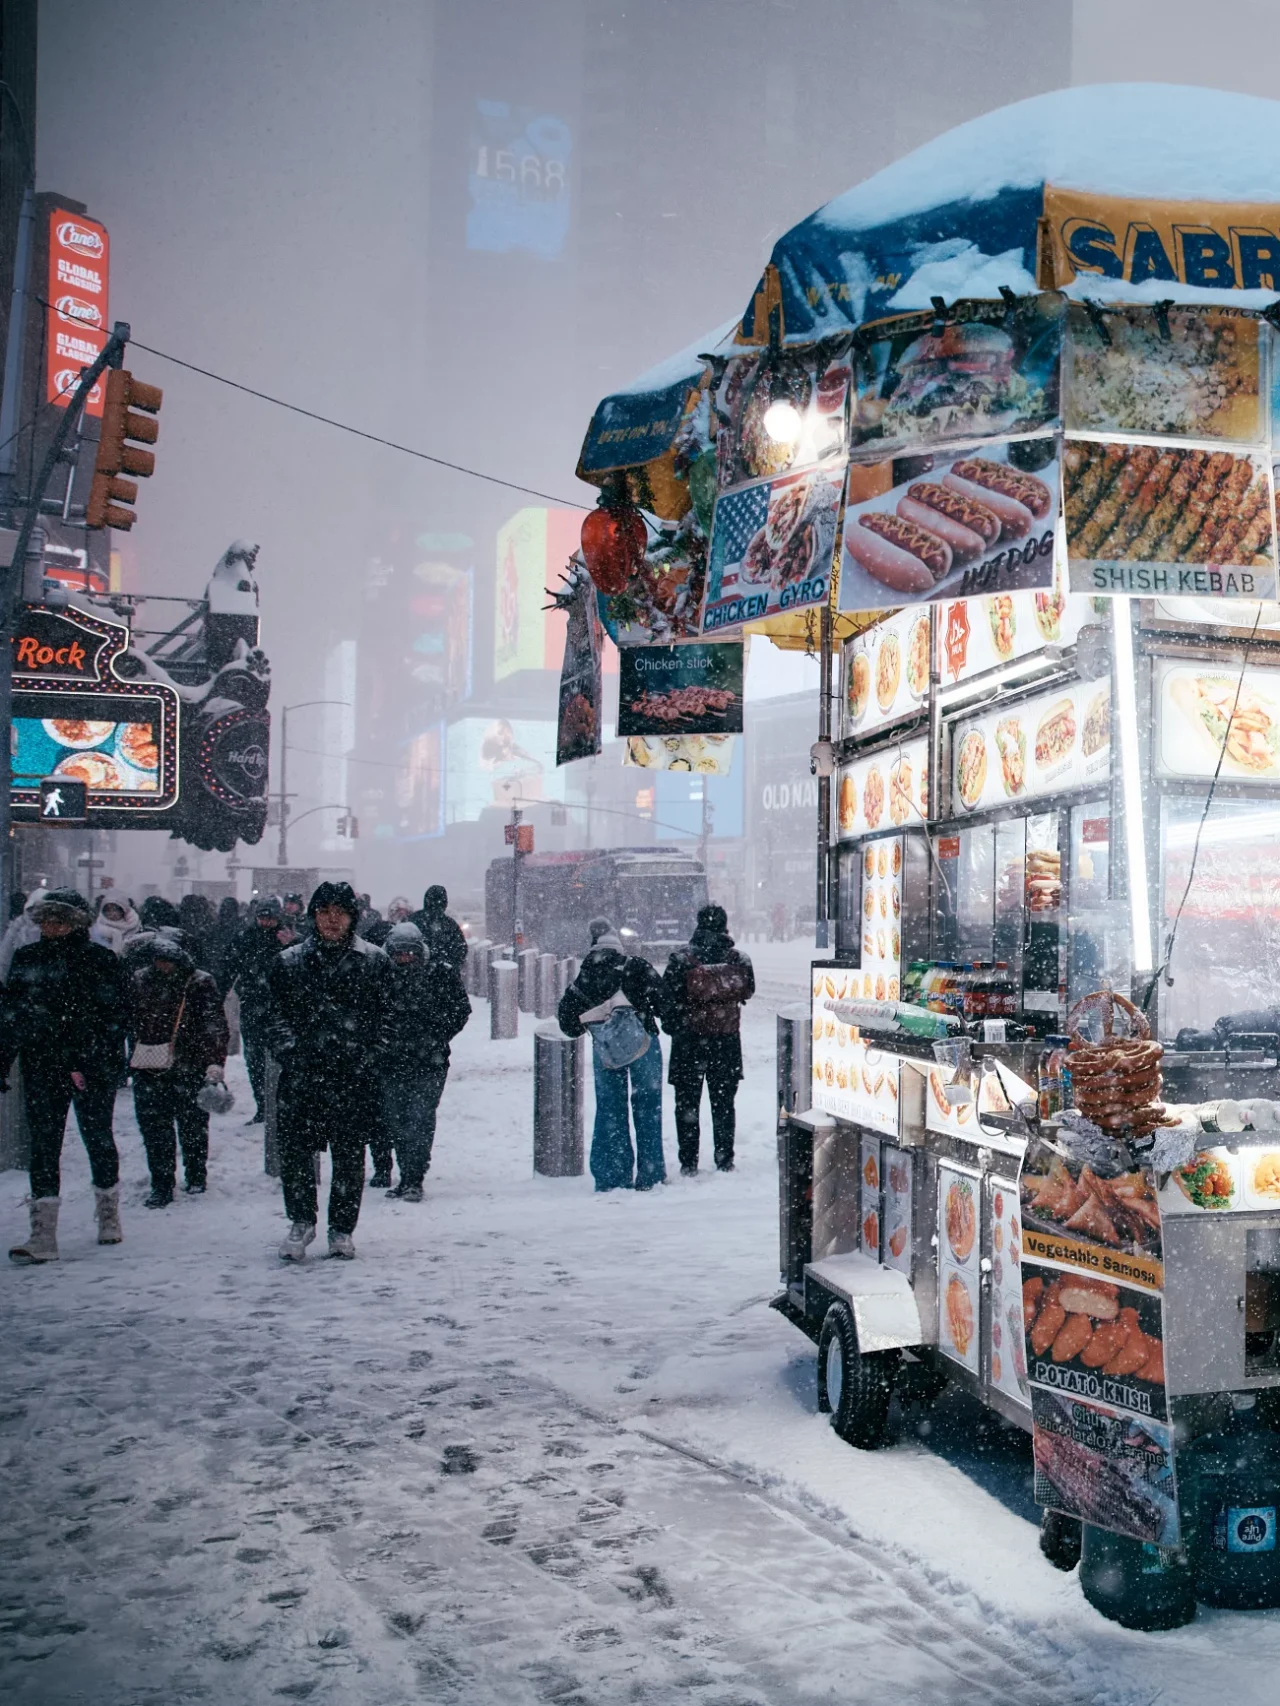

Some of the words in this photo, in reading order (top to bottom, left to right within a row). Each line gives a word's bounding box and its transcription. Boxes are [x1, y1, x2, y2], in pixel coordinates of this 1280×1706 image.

[58, 259, 102, 284] GLOBAL
[56, 333, 100, 357] GLOBAL
[1006, 530, 1054, 573] DOG
[779, 576, 826, 609] GYRO
[1093, 568, 1168, 591] SHISH
[1177, 573, 1254, 593] KEBAB
[17, 637, 86, 670] Rock
[634, 657, 683, 671] Chicken
[686, 656, 714, 670] stick
[763, 783, 789, 810] OLD
[792, 781, 818, 808] NAV
[1027, 1237, 1099, 1268] Vegetable
[1103, 1256, 1156, 1284] Samosa
[1035, 1363, 1097, 1396] POTATO
[1102, 1380, 1151, 1414] KNISH
[1242, 1534, 1262, 1542] Pure
